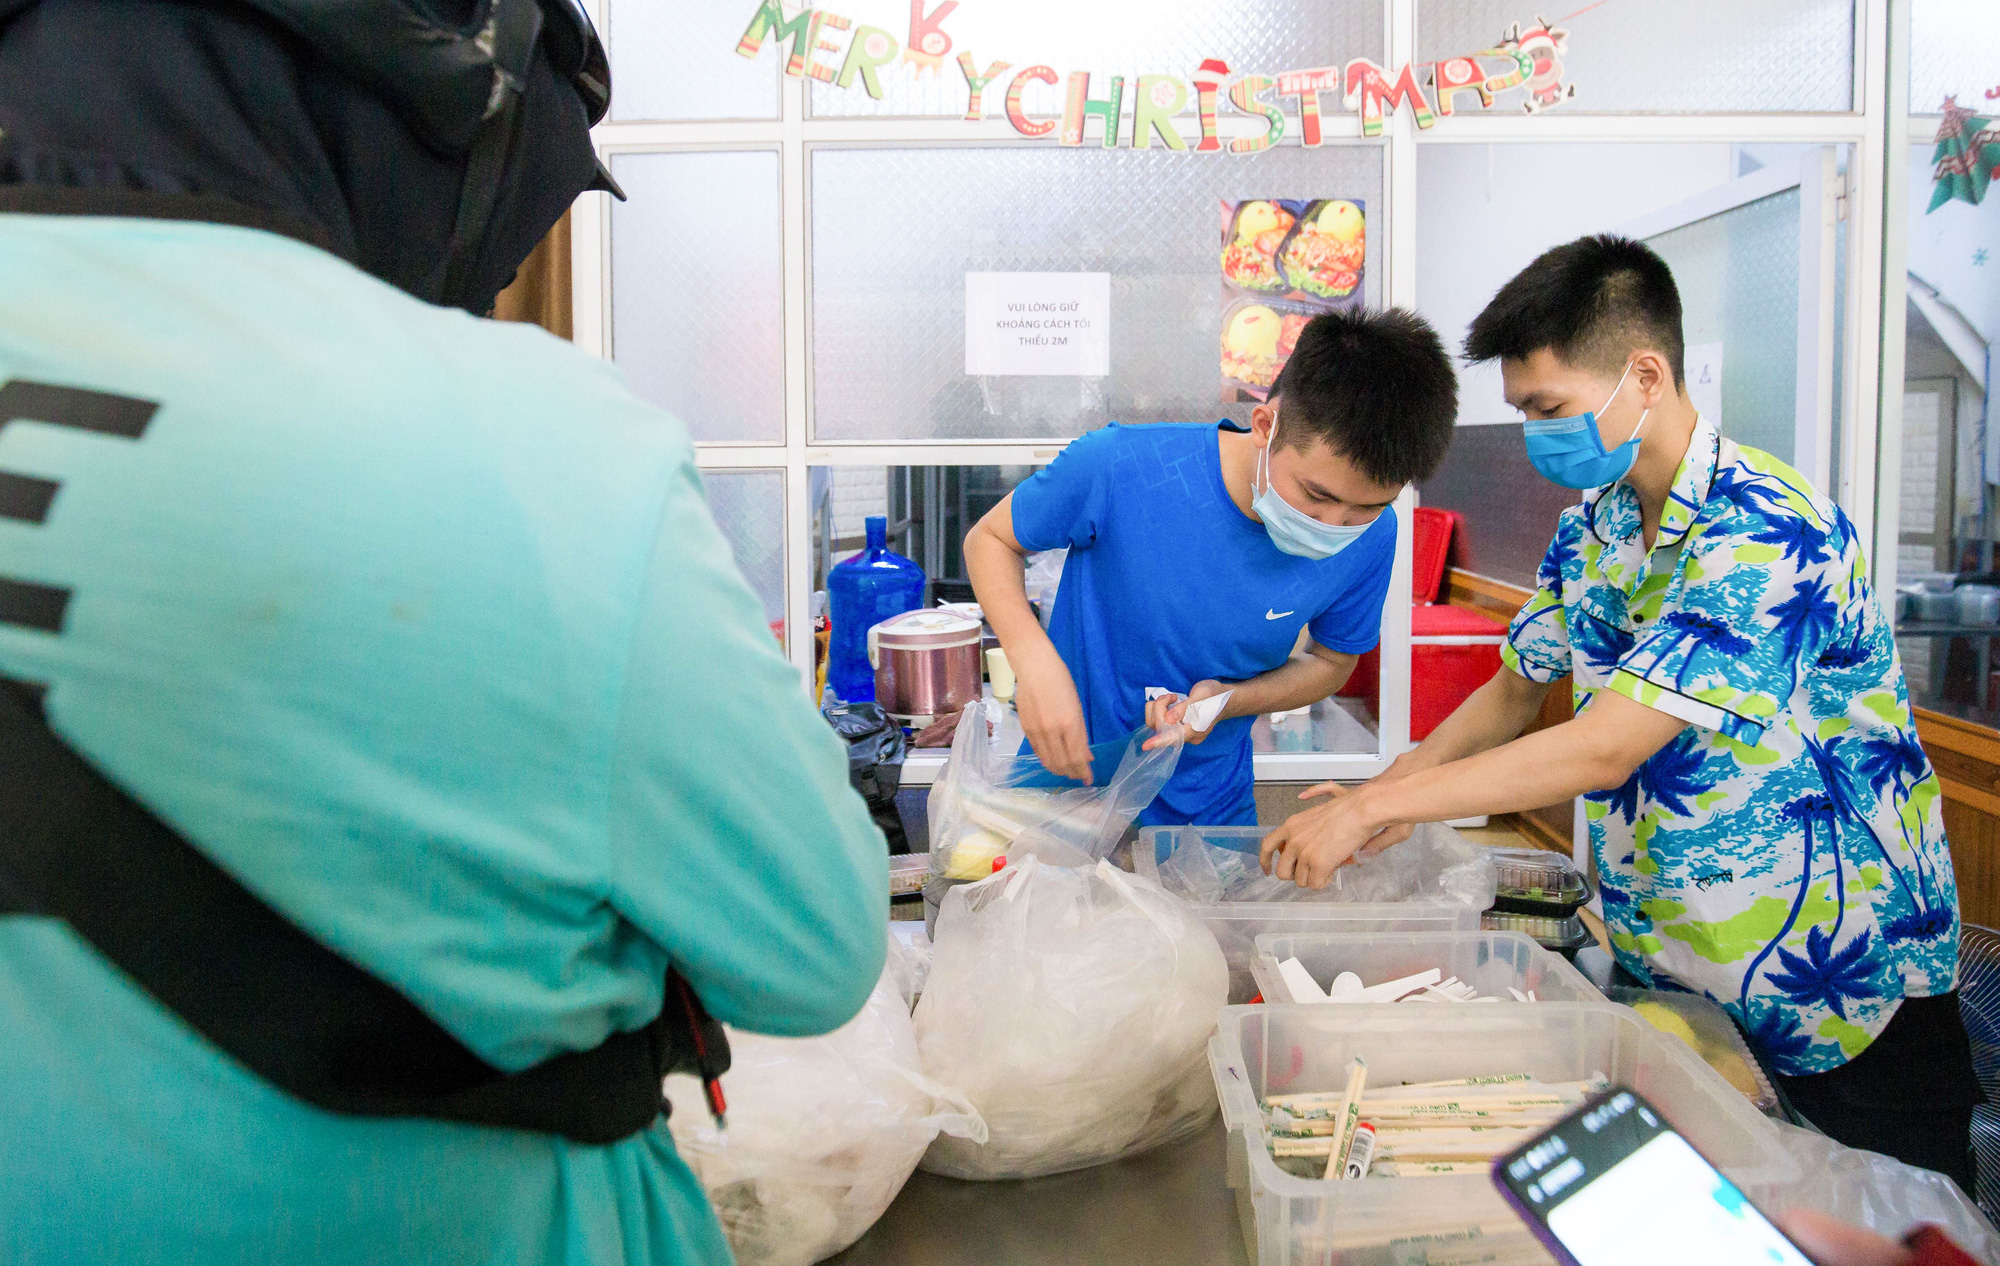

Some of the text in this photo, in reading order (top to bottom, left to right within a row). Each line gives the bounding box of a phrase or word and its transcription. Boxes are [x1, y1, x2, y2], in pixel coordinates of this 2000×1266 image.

[1007, 303, 1025, 312] VUI
[1028, 301, 1056, 312] LÒNG
[1043, 317, 1071, 329] CÁCH
[1051, 337, 1068, 346] 2M
